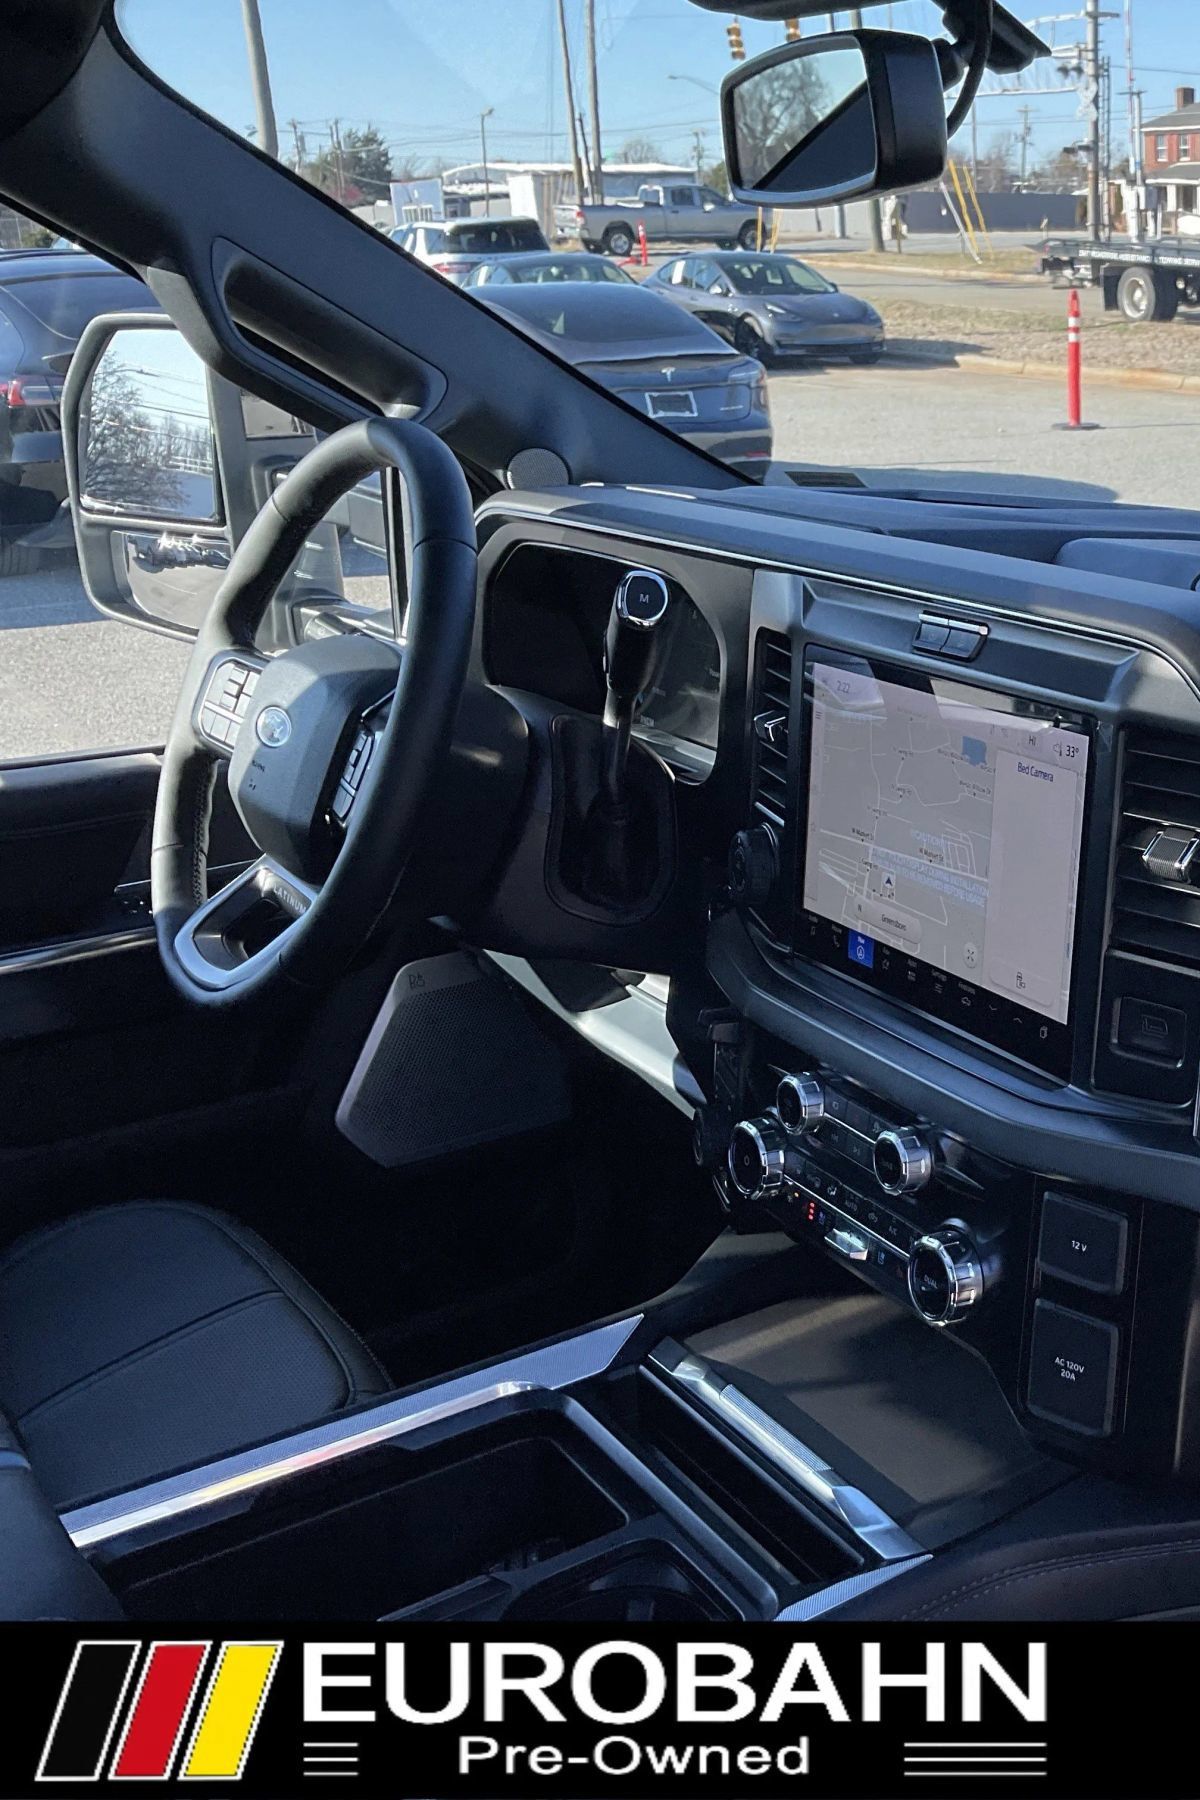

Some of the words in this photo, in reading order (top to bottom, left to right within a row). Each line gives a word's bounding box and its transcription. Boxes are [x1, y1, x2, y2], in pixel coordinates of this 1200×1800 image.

[640, 593, 649, 603] M
[1017, 761, 1030, 775] Bed
[1030, 765, 1054, 783] Camera
[271, 881, 307, 914] LATINUM
[1071, 1240, 1081, 1251] 12
[923, 1273, 939, 1289] DUAL
[1054, 1356, 1065, 1367] AC
[1066, 1359, 1085, 1374] 120V
[1060, 1368, 1076, 1382] 20A
